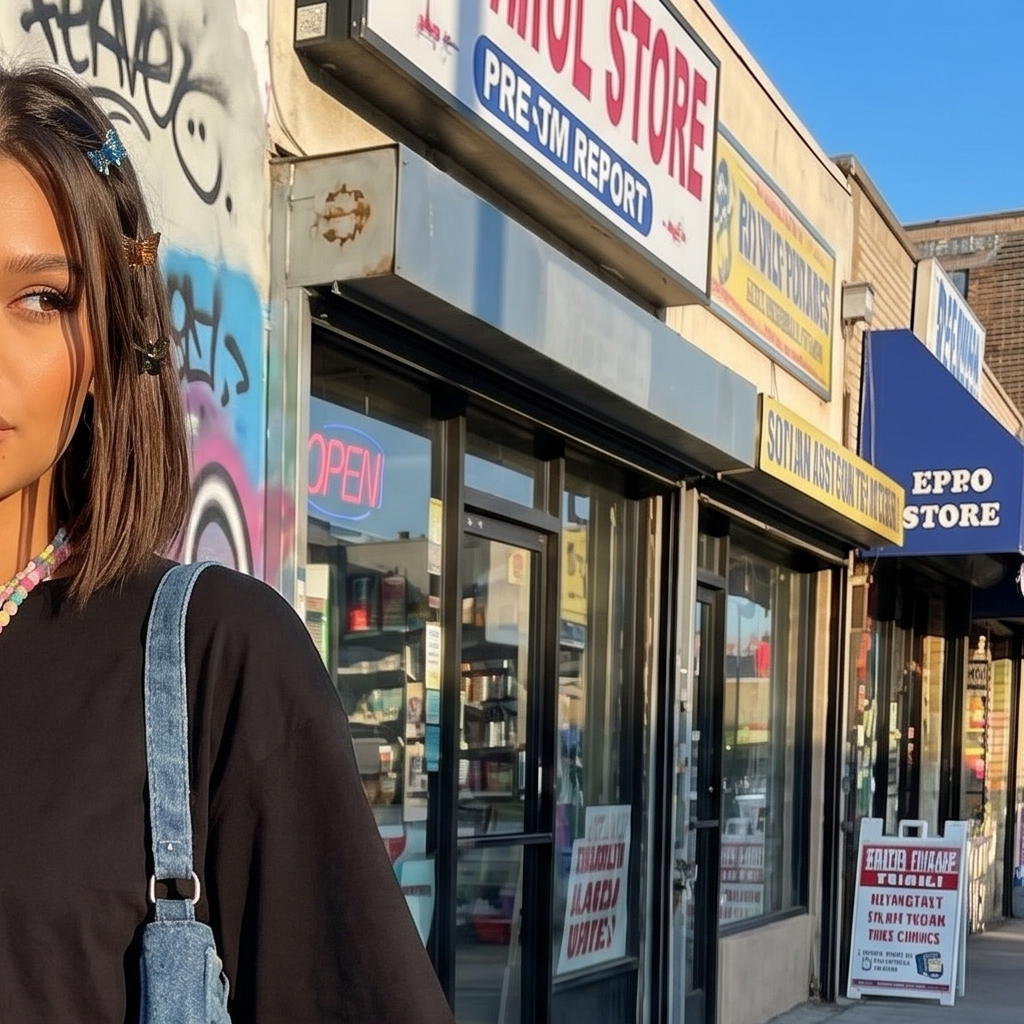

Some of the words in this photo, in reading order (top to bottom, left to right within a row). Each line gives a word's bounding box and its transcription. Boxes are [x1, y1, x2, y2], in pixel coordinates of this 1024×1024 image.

[606, 0, 708, 202] STORE
[573, 128, 648, 225] REPORT
[307, 432, 382, 508] OPEN
[902, 502, 1000, 530] STORE
